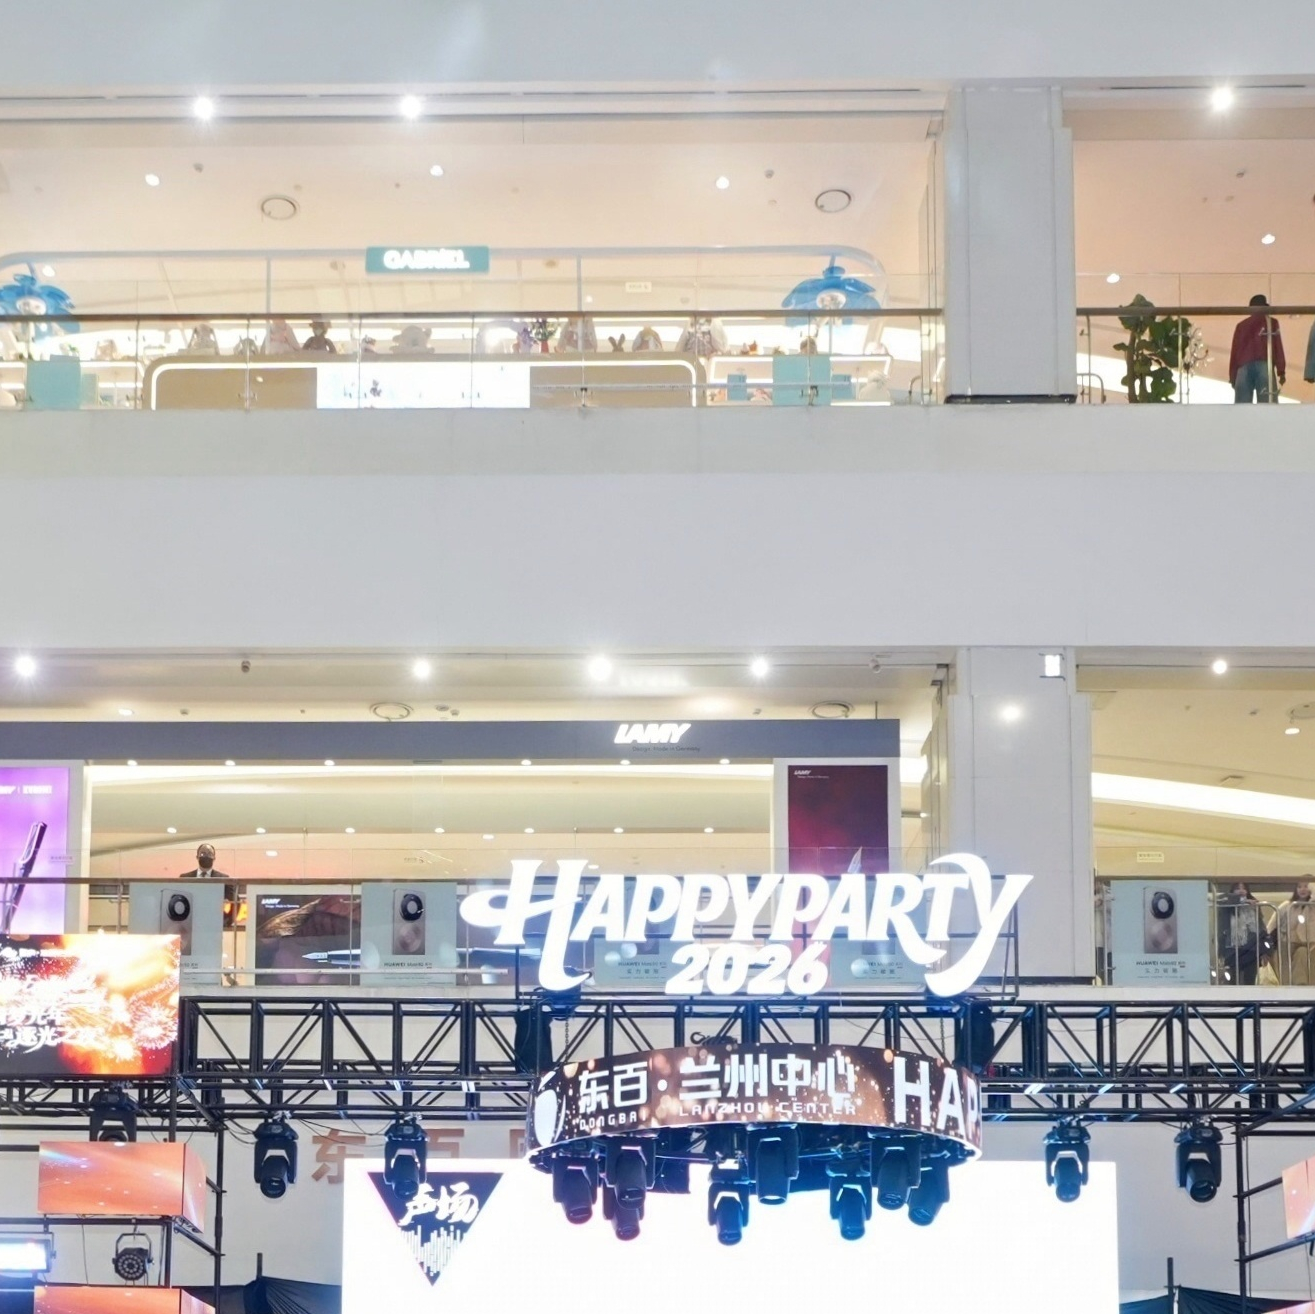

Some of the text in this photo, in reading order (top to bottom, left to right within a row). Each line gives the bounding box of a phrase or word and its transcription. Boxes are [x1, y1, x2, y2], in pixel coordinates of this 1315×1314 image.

[614, 723, 691, 744] LAMY
[664, 942, 829, 996] 2026
[678, 1101, 857, 1117] LANZHOU CENTER
[579, 1112, 647, 1131] DONGBAI
